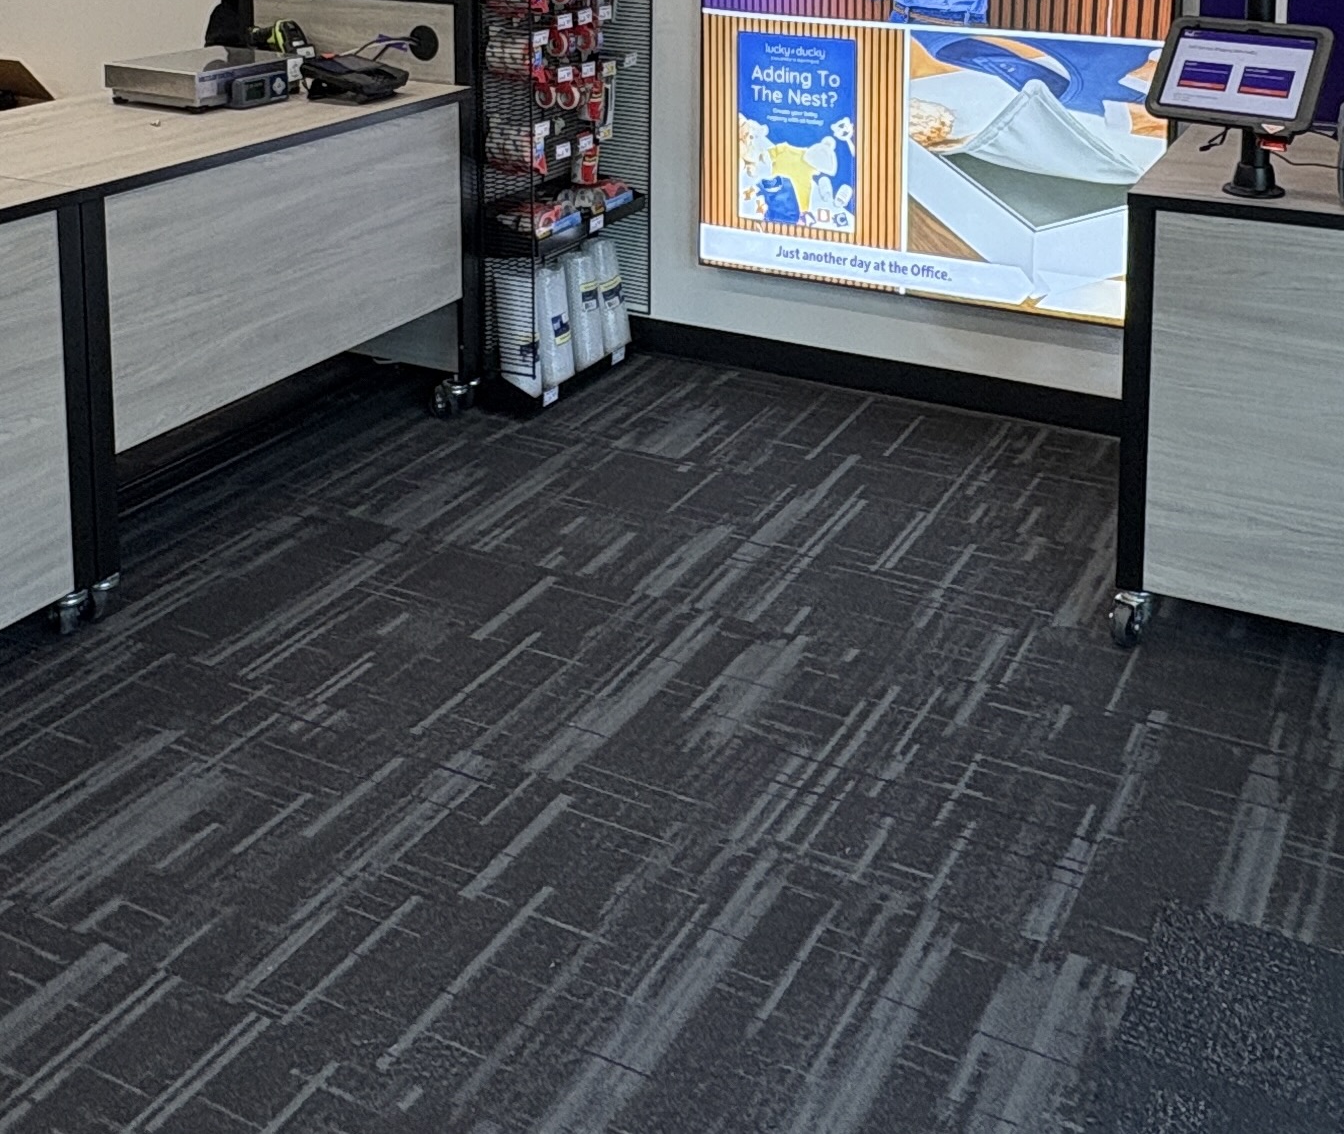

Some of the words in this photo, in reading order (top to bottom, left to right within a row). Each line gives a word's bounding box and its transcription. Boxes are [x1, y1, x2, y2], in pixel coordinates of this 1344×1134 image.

[764, 43, 791, 57] lucky
[796, 46, 826, 60] ducky
[751, 65, 812, 89] Adding
[817, 70, 840, 87] To
[751, 84, 783, 103] The
[788, 88, 838, 108] Nest?
[776, 245, 800, 259] Just
[802, 250, 848, 266] another
[849, 255, 870, 272] day
[873, 259, 886, 271] at
[888, 259, 908, 275] the
[910, 263, 952, 282] Office.
